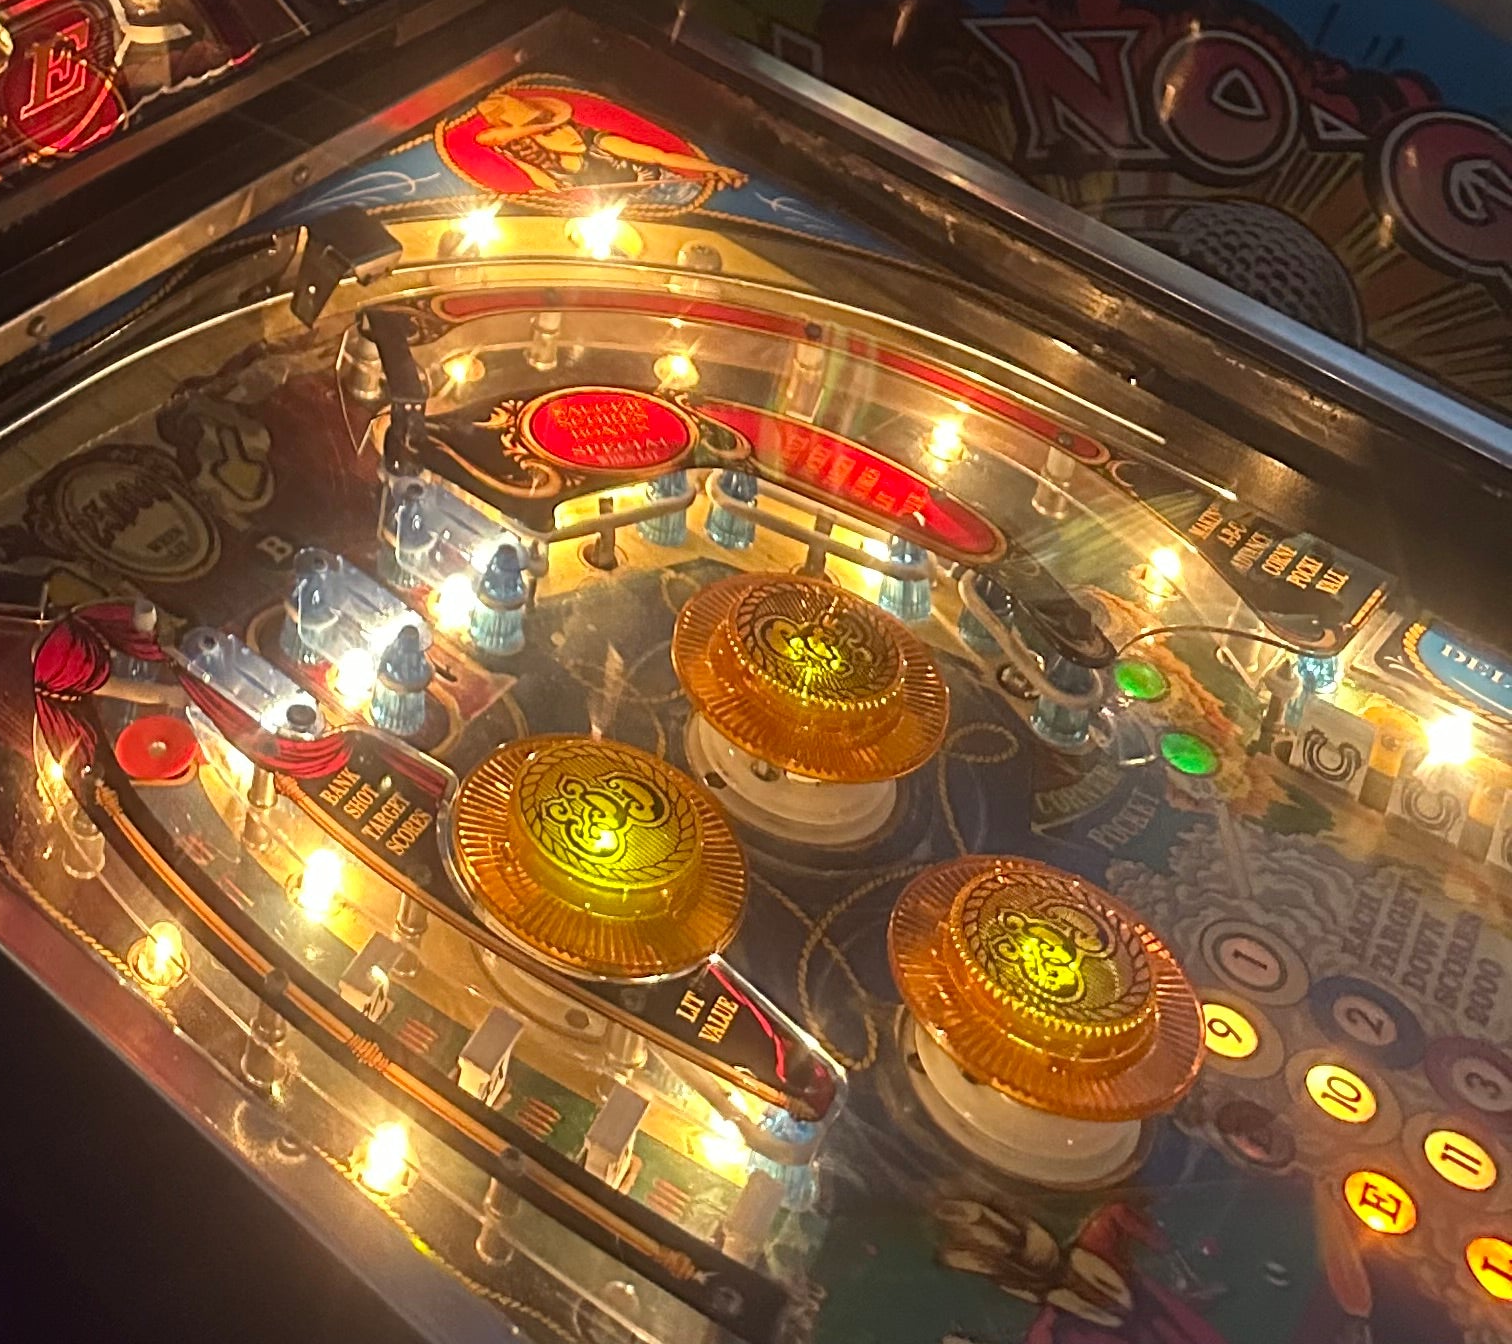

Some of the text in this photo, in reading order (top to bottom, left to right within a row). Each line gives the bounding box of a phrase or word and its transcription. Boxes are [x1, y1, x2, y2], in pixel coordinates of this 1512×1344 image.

[319, 766, 362, 807] BANK
[343, 783, 381, 820] SHOT
[360, 791, 412, 841] TARGET
[385, 807, 434, 857] SCORES
[1340, 889, 1384, 962] EACH
[1368, 876, 1423, 977] TARGET
[1233, 948, 1269, 972] 1
[1401, 911, 1448, 996] DOWN
[675, 990, 706, 1024] LIT
[1464, 957, 1506, 1027] 2000
[697, 995, 740, 1045] VALUE
[1207, 1017, 1243, 1044] 9
[1346, 1007, 1385, 1039] 2
[1320, 1074, 1363, 1115] 10
[1465, 1071, 1502, 1100] 3
[1439, 1141, 1484, 1176] 11
[1358, 1181, 1403, 1226] E
